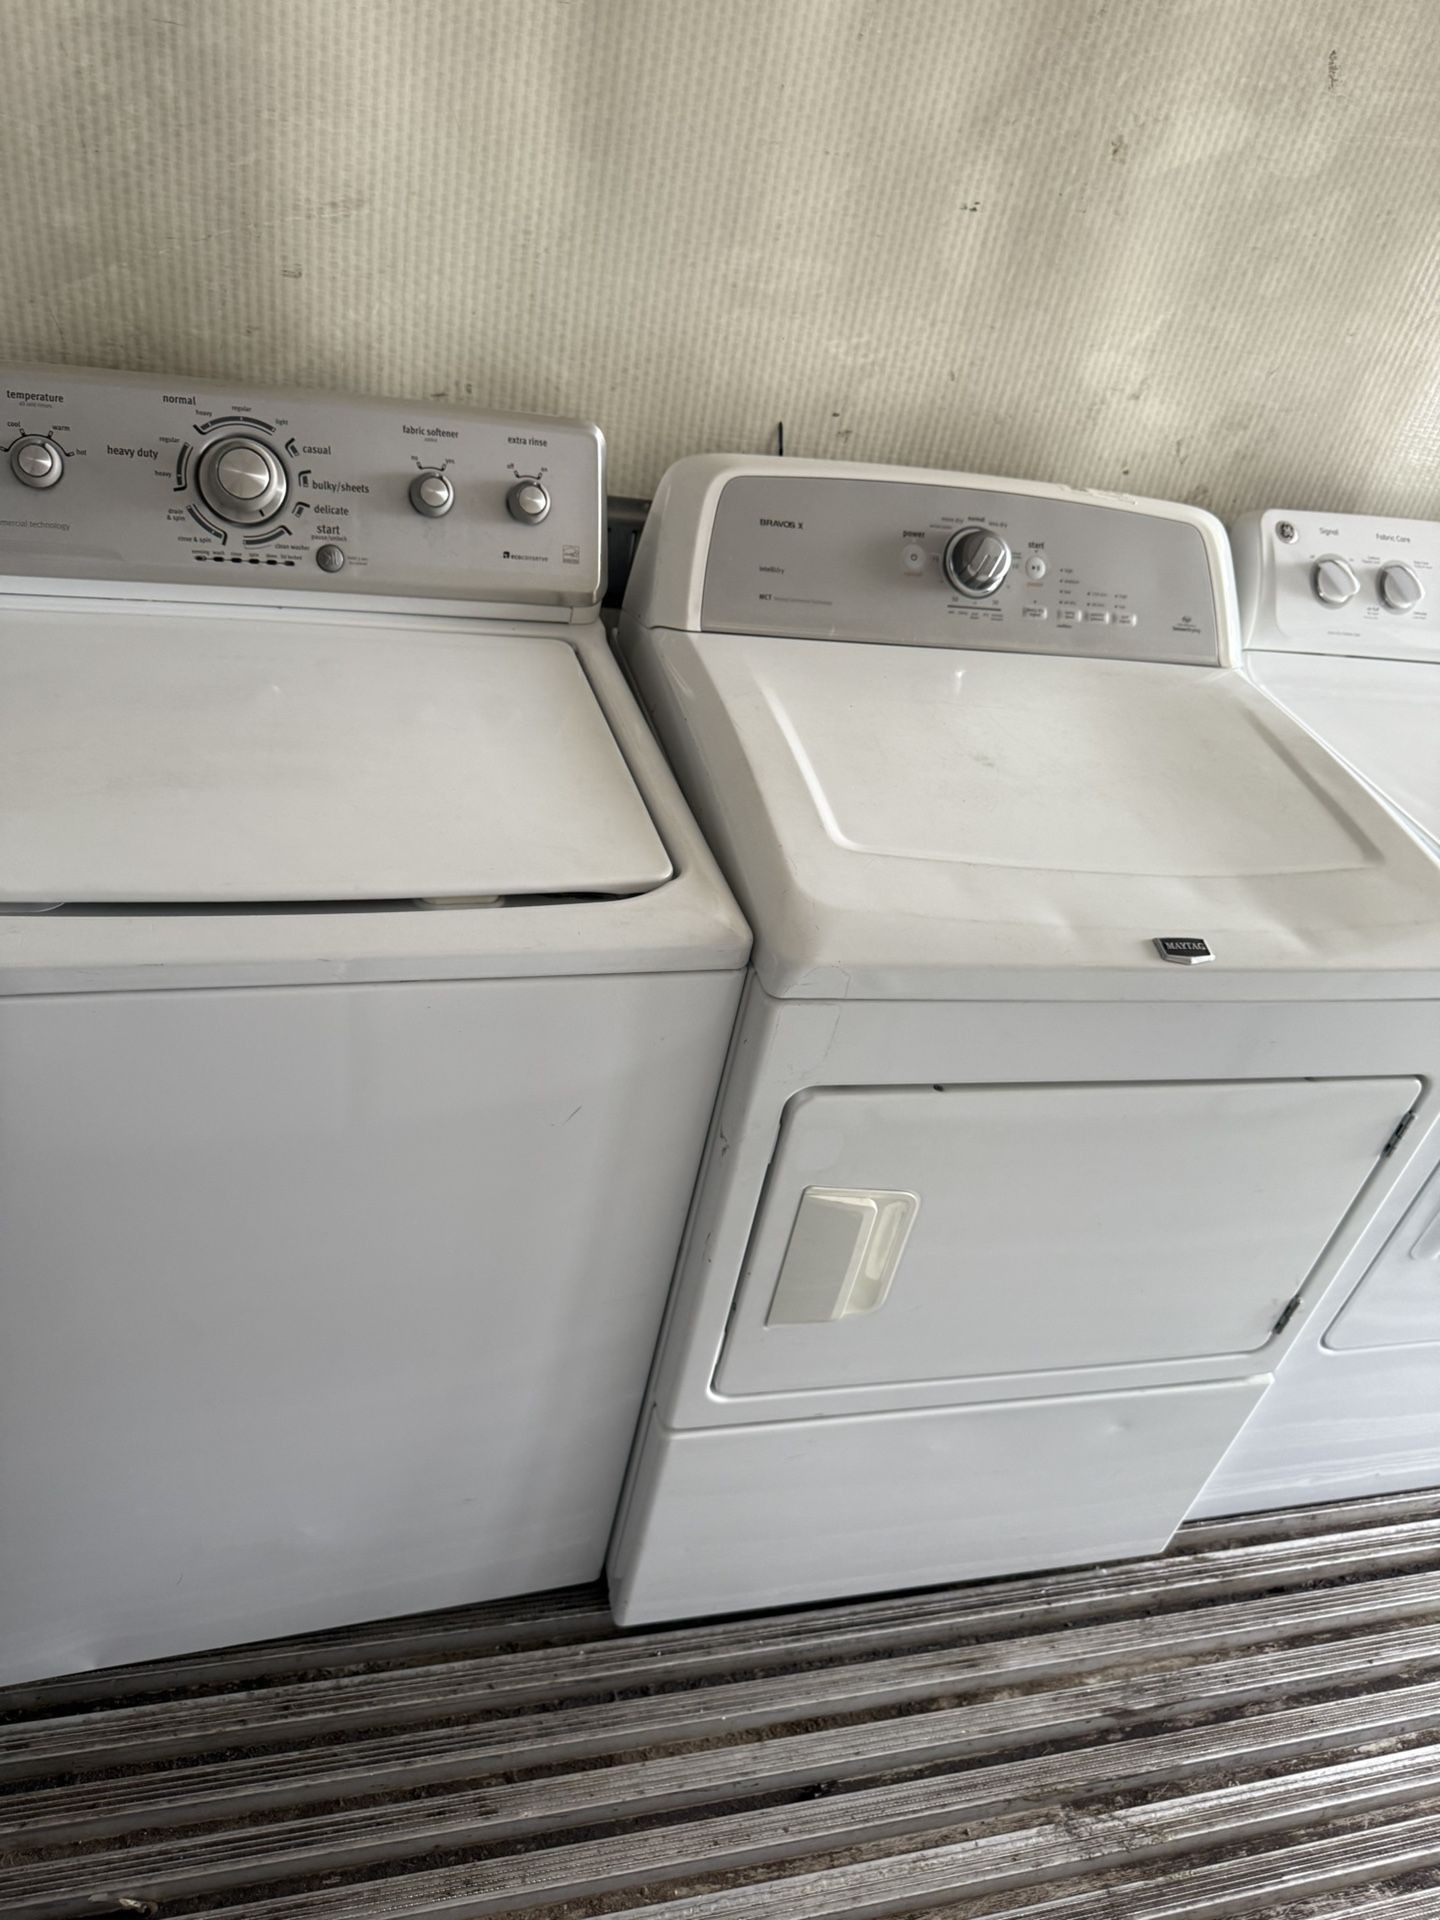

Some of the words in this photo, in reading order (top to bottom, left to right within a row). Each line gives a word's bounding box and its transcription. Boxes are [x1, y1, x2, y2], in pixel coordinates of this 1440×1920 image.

[6, 389, 64, 403] temperature
[162, 394, 197, 406] normal
[195, 409, 213, 418] heavy
[52, 424, 71, 432] warm
[402, 424, 425, 437] fabric
[426, 427, 459, 439] softener
[507, 436, 528, 446] extra
[528, 437, 548, 448] rinse
[107, 444, 135, 459] heavy
[137, 447, 159, 461] duty
[302, 445, 332, 455] casual
[154, 470, 172, 479] heavy
[312, 480, 370, 494] bulky/sheets
[313, 504, 350, 517] delicate
[316, 524, 341, 535] start
[759, 518, 796, 530] BRAVOS
[902, 530, 926, 539] power
[1027, 541, 1046, 550] start
[1164, 941, 1207, 951] MAYTAG
